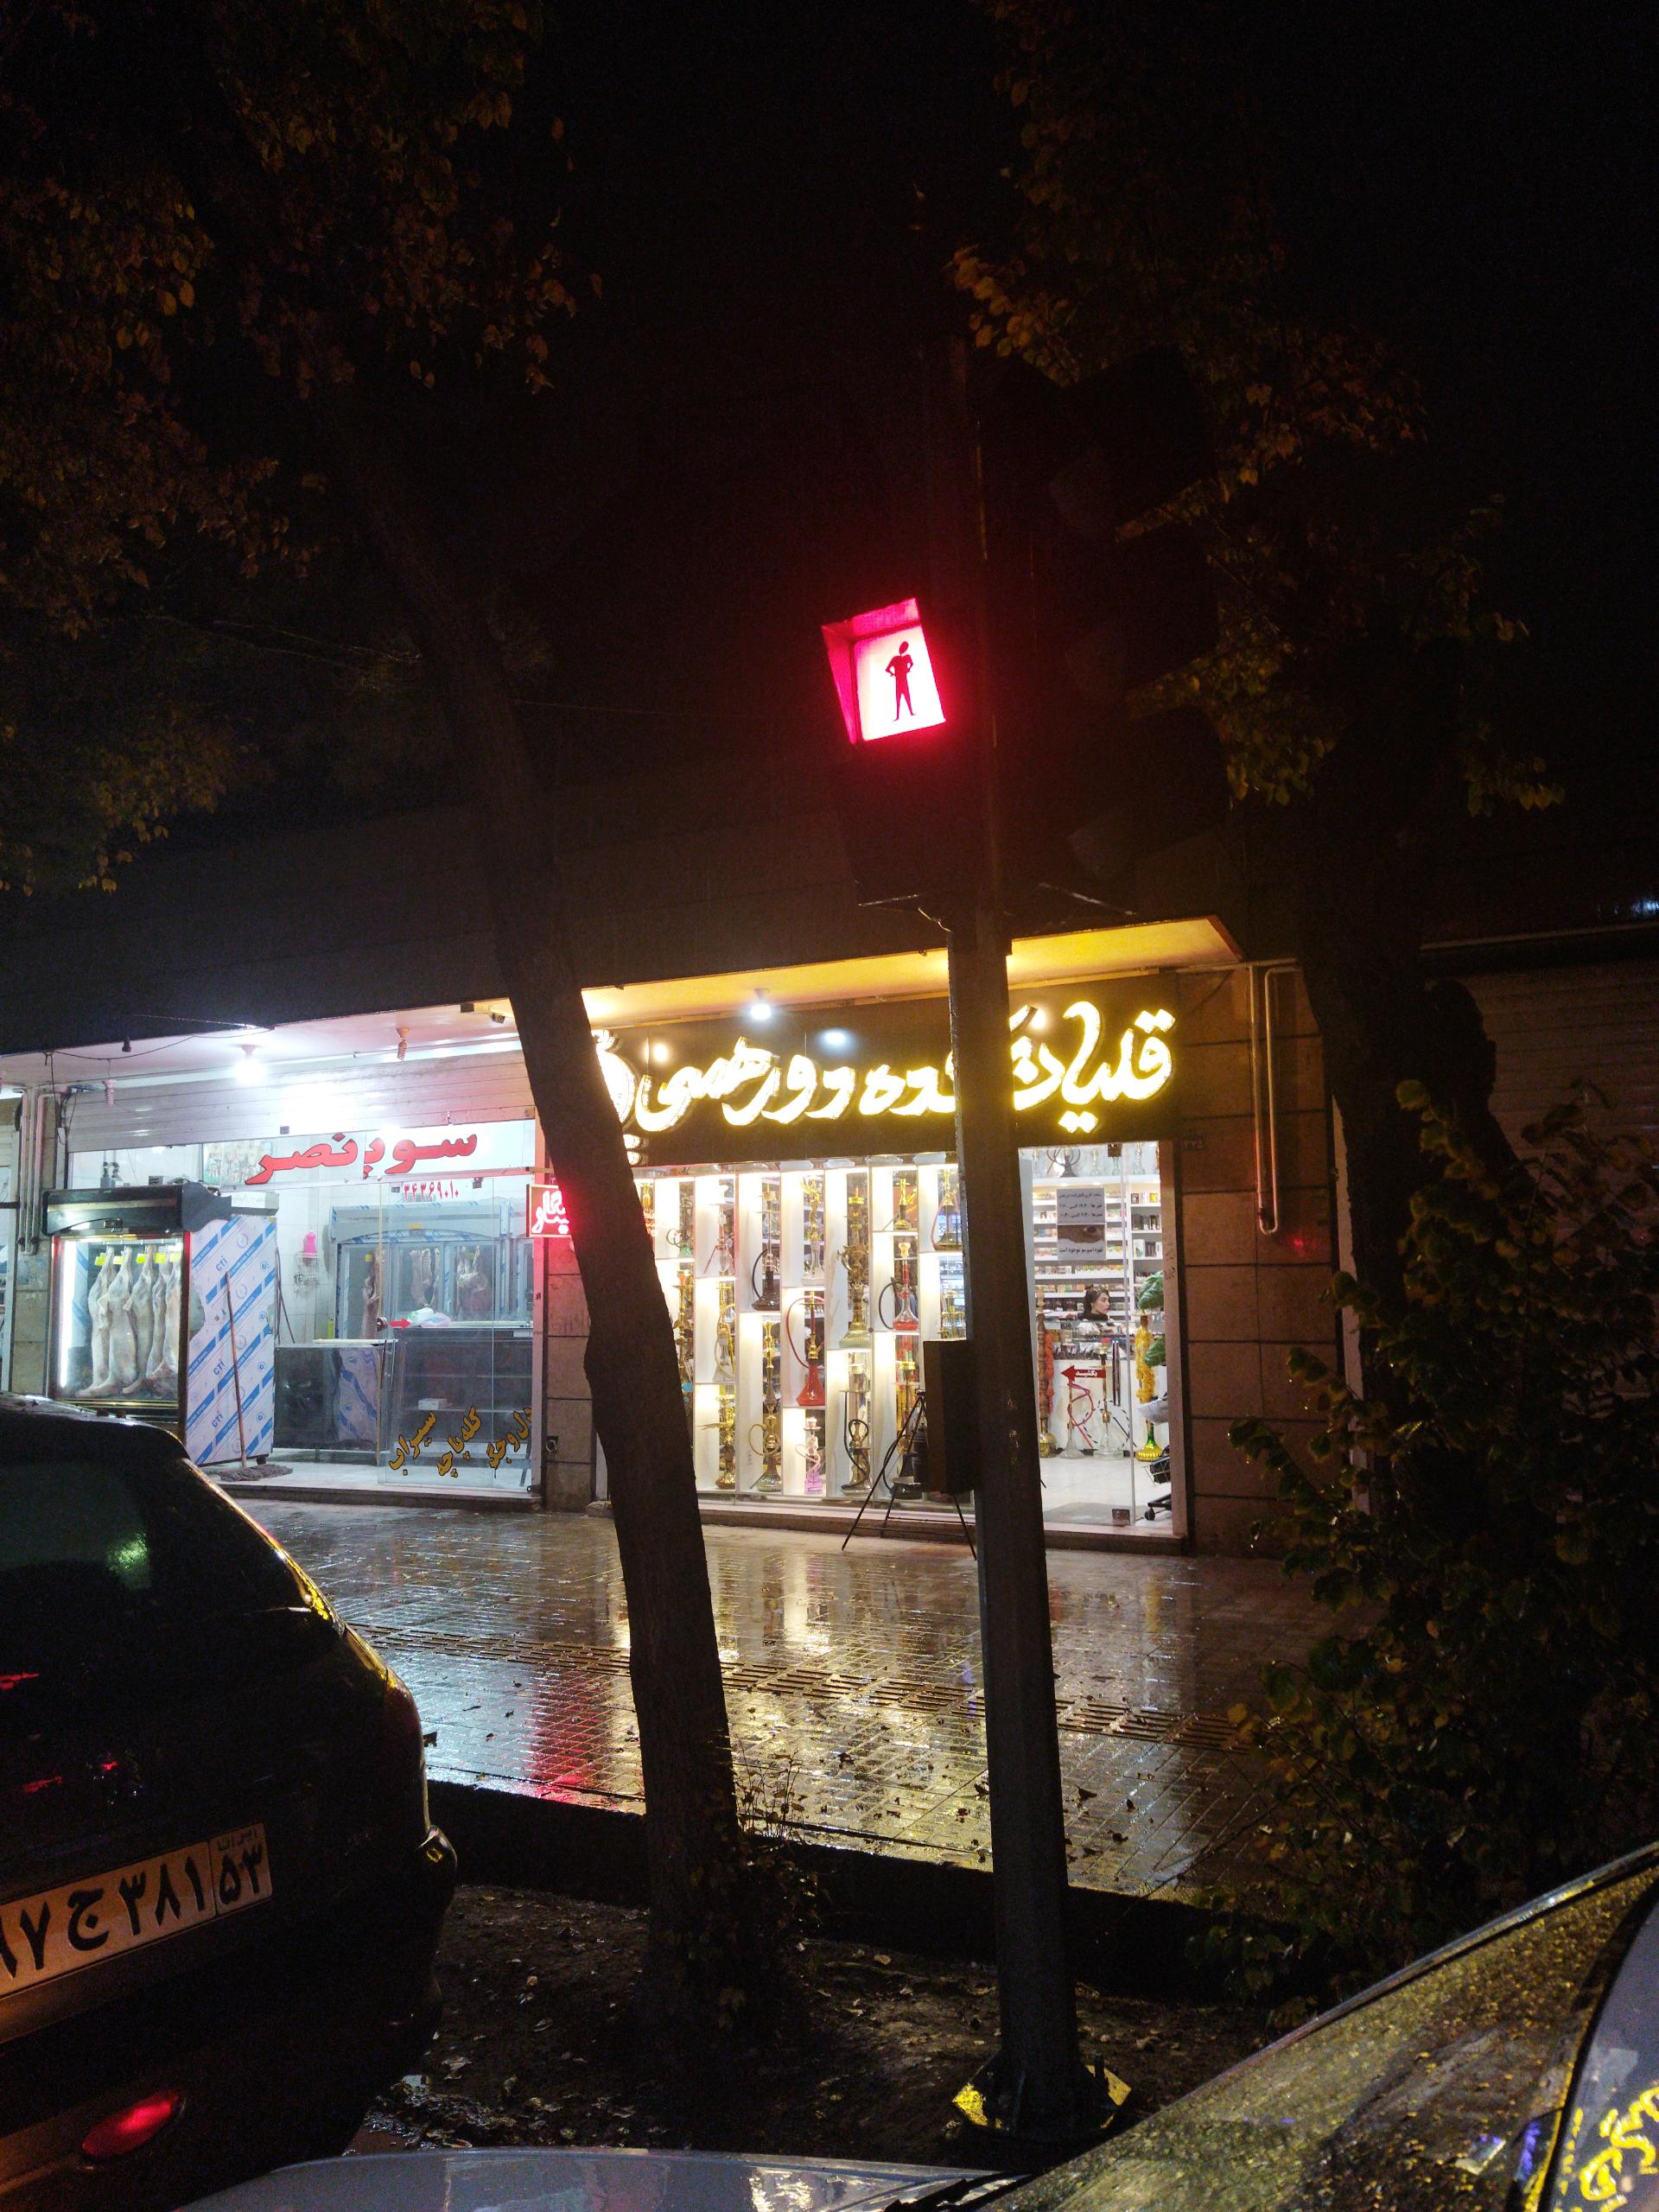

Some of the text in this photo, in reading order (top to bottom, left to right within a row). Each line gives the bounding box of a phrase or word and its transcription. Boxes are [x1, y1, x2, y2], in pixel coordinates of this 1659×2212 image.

[245, 1132, 477, 1185] سوپ نصر
[404, 1180, 459, 1201] ۳۴۳۶۹۰۱۰
